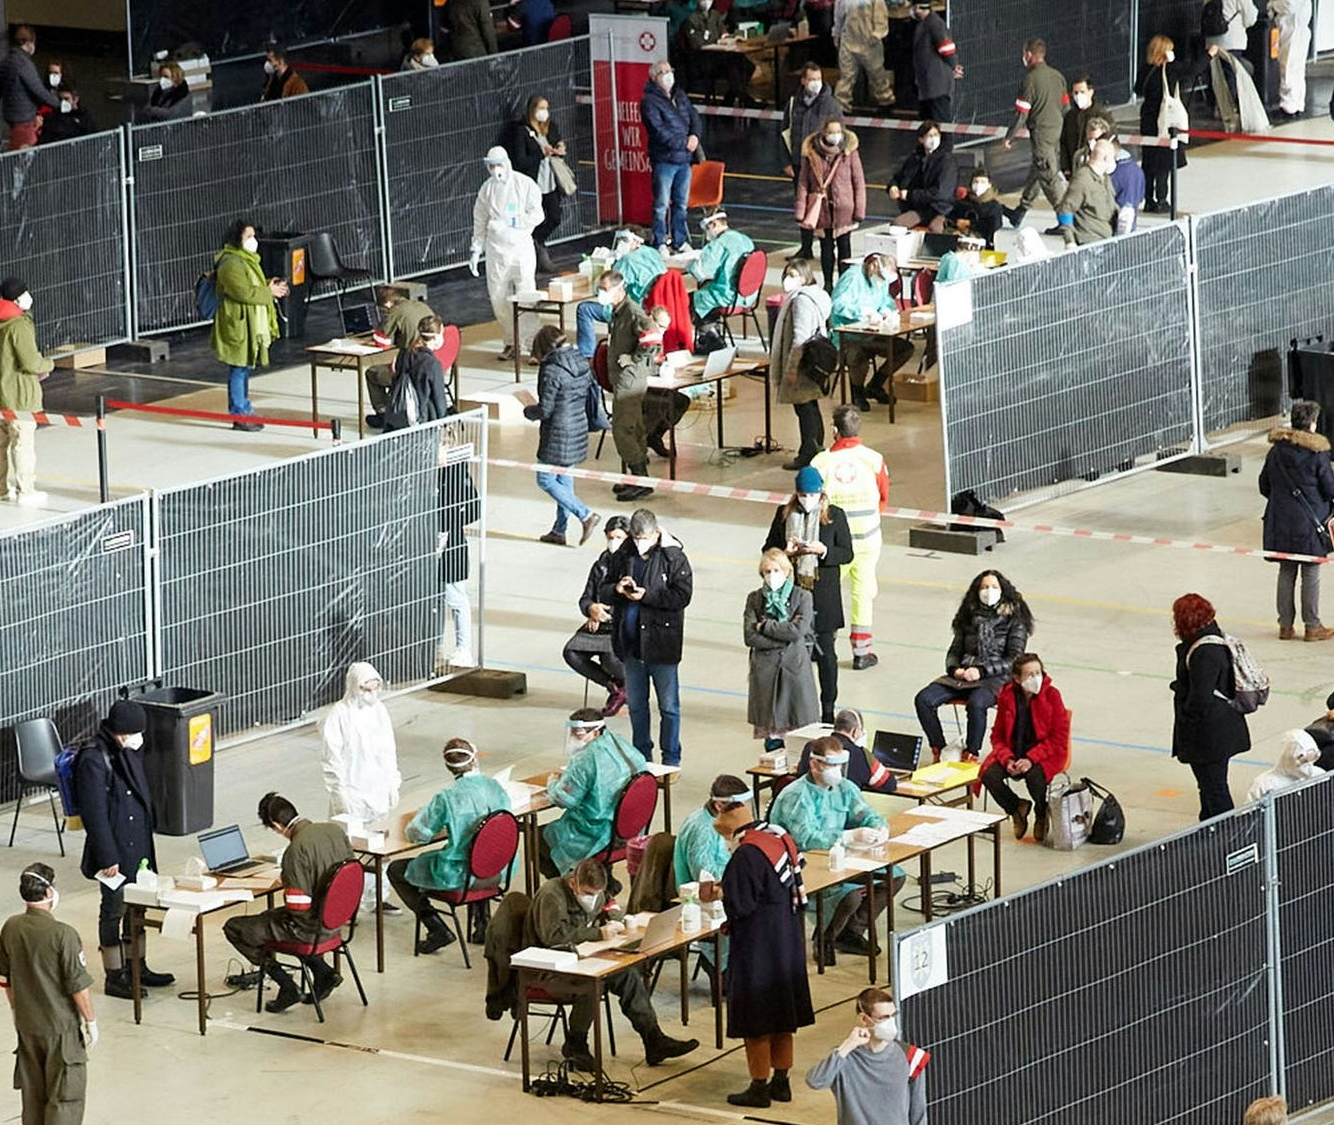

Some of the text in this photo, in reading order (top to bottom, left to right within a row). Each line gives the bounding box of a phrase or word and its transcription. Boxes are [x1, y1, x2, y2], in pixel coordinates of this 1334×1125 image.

[617, 101, 642, 123] HELFE
[622, 126, 642, 148] WIR
[604, 149, 653, 173] GEMEINSA
[913, 950, 929, 971] 12
